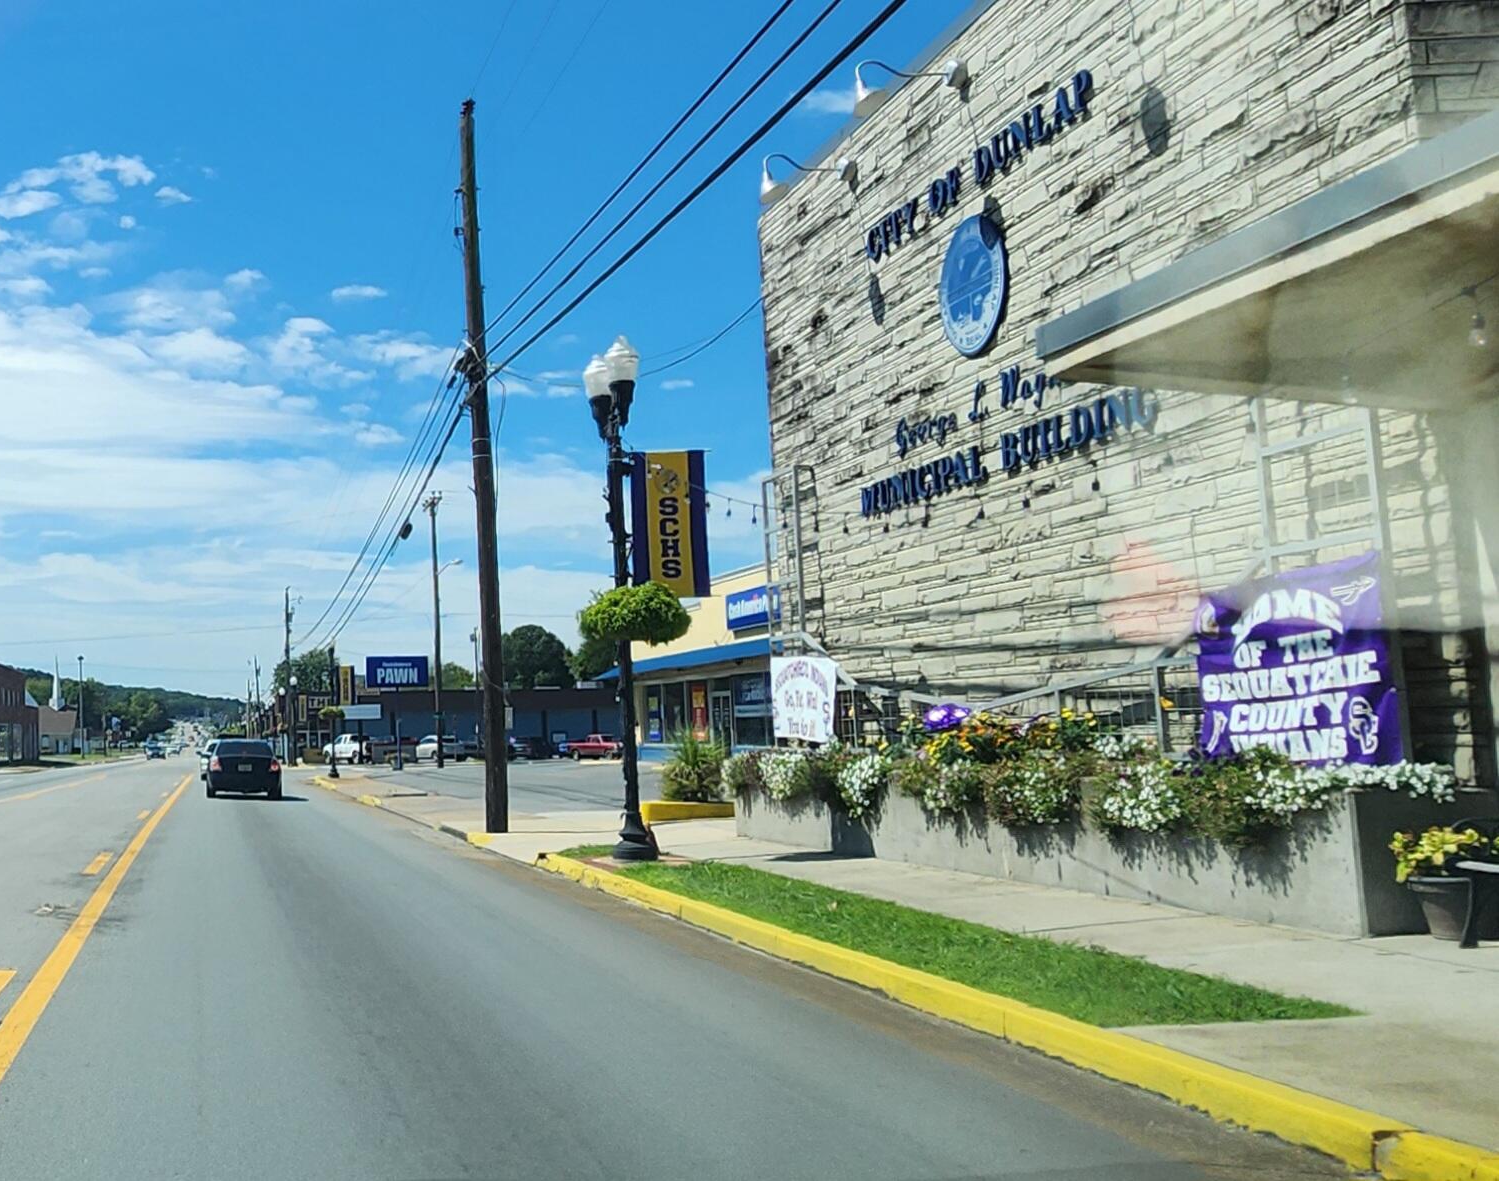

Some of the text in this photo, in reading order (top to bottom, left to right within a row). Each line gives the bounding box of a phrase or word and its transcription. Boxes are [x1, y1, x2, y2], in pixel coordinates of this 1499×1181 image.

[866, 69, 1093, 261] CITY OF DUNLAP
[861, 387, 1157, 516] MUNICIPAL BUILDING
[897, 412, 958, 460] George
[659, 497, 681, 579] SCHS
[1233, 629, 1334, 669] OF THE
[376, 667, 418, 684] PAWN
[1202, 650, 1381, 702] SEQUATCHIE
[1229, 692, 1348, 732] COUNTY
